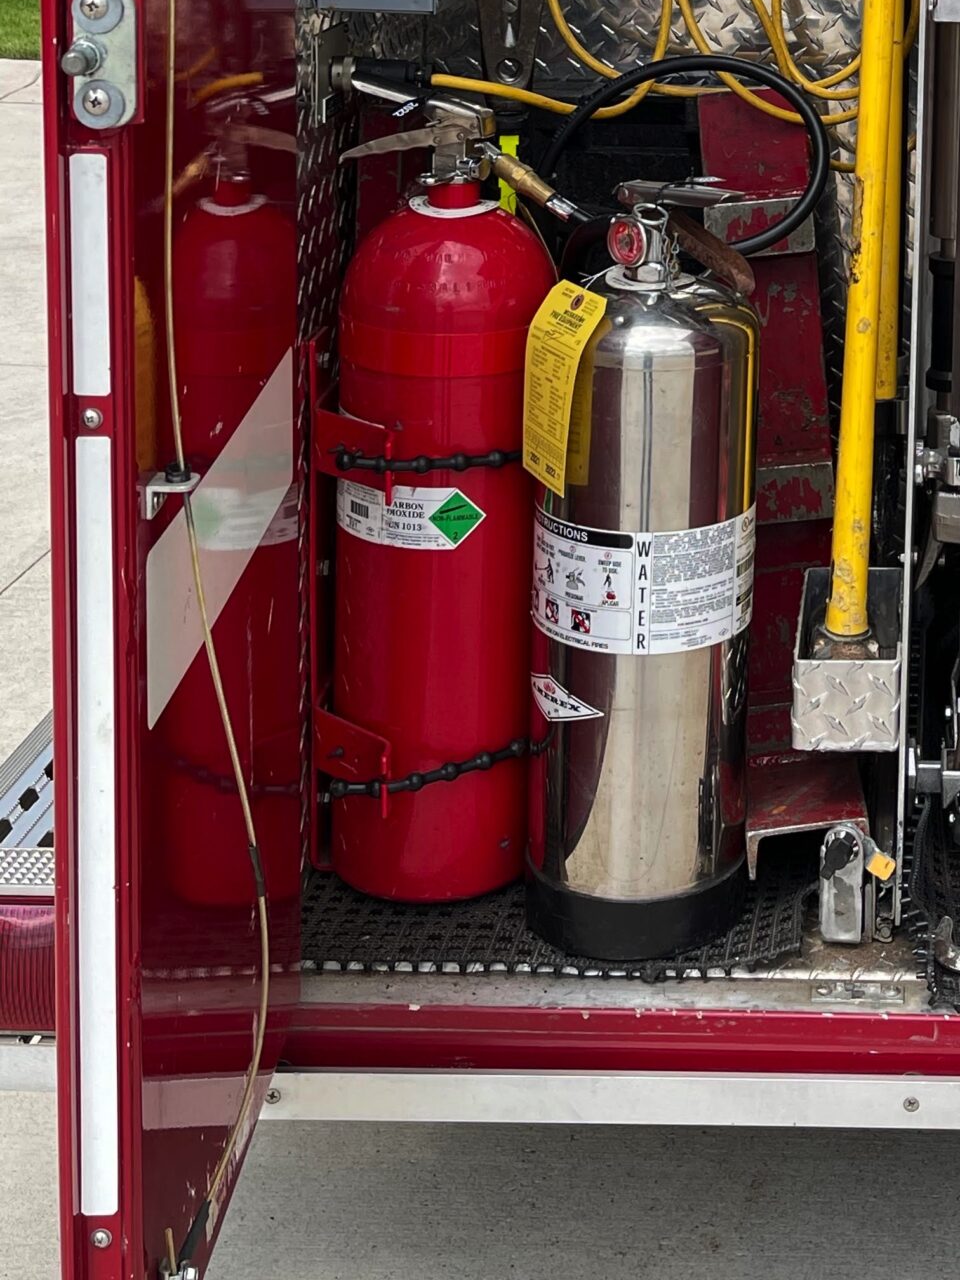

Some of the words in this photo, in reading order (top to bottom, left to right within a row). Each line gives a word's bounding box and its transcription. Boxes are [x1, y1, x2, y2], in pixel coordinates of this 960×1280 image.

[392, 501, 424, 511] ARBON
[401, 521, 422, 531] 1013
[452, 531, 459, 540] 2
[636, 540, 651, 650] WATER
[559, 634, 591, 647] ELECTRICAL
[591, 641, 609, 650] FIRES
